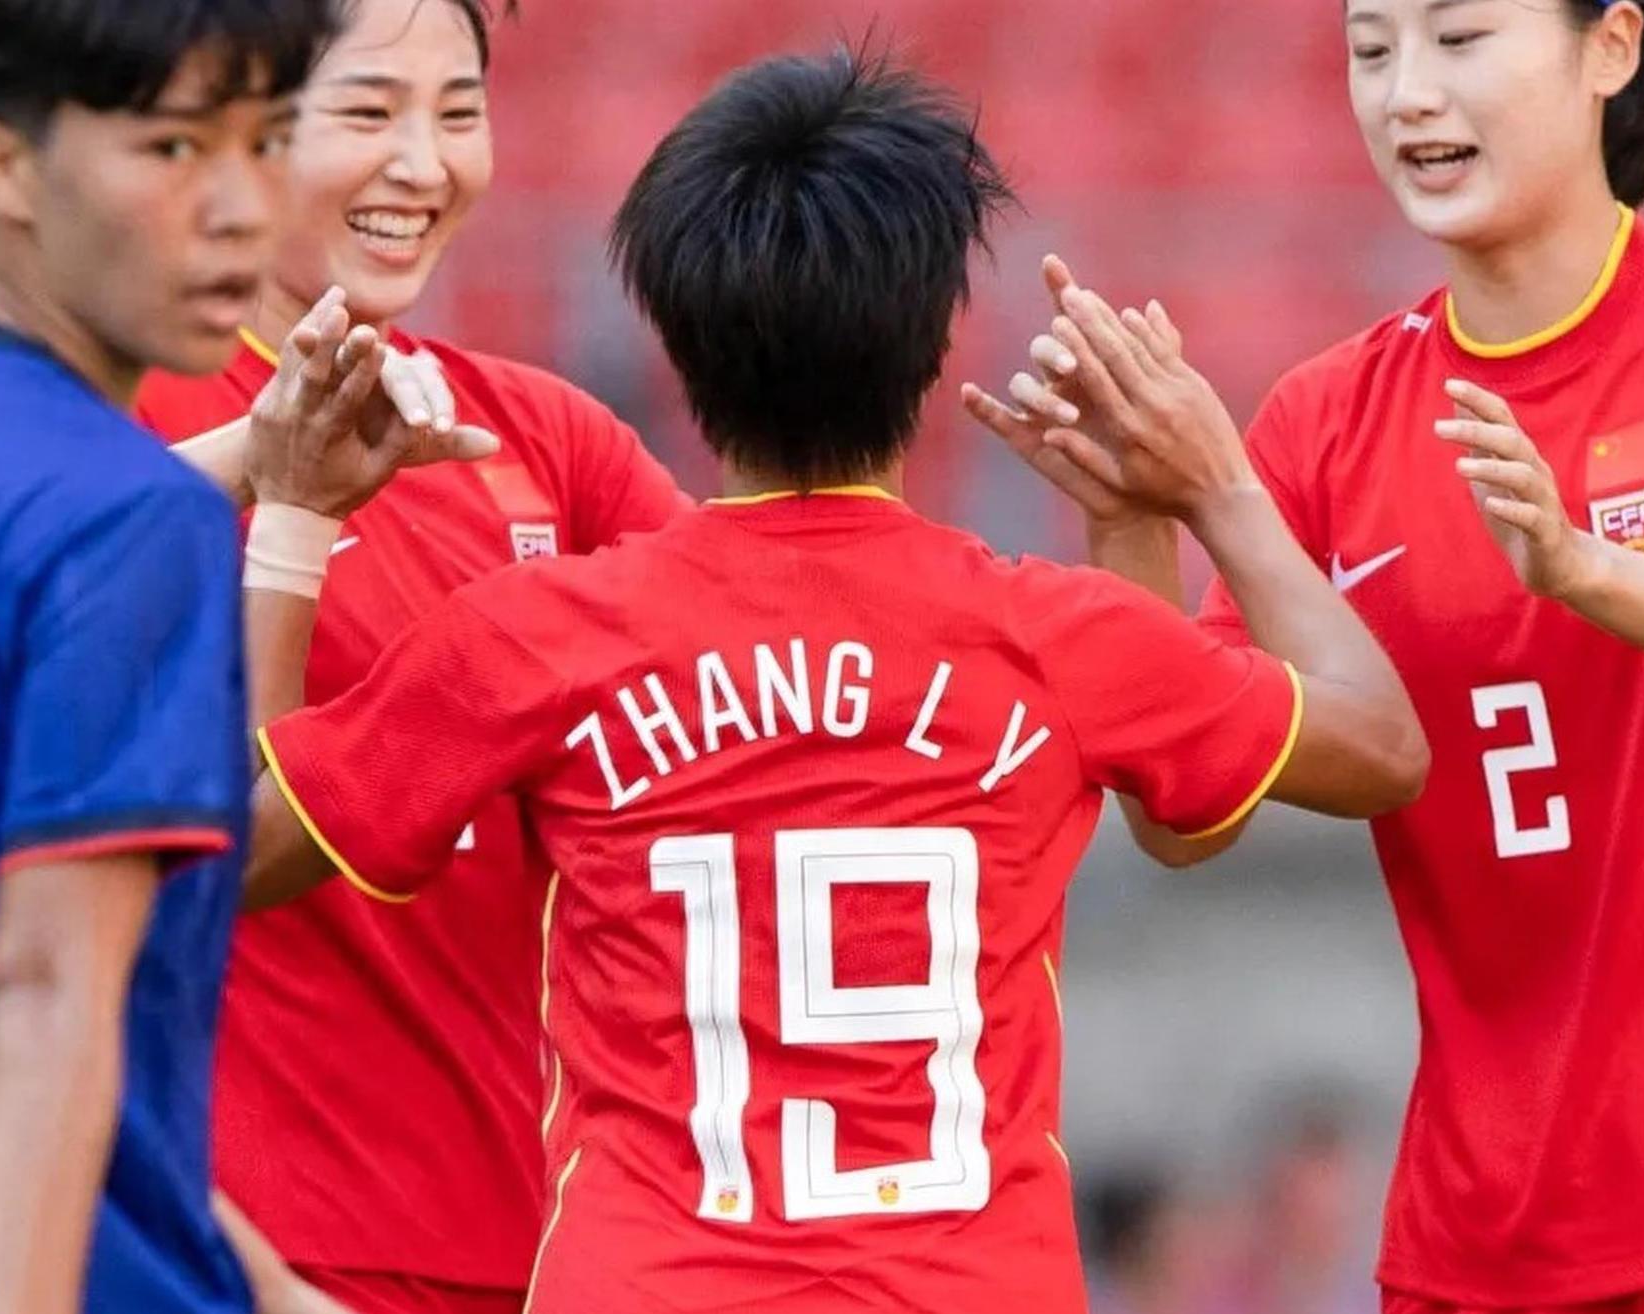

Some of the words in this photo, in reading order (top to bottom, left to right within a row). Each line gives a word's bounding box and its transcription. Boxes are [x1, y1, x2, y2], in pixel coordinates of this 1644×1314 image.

[564, 637, 875, 811] ZHANG
[905, 661, 953, 761] L
[977, 700, 1052, 794] Y
[1470, 680, 1572, 859] 2
[649, 827, 991, 1222] 19
